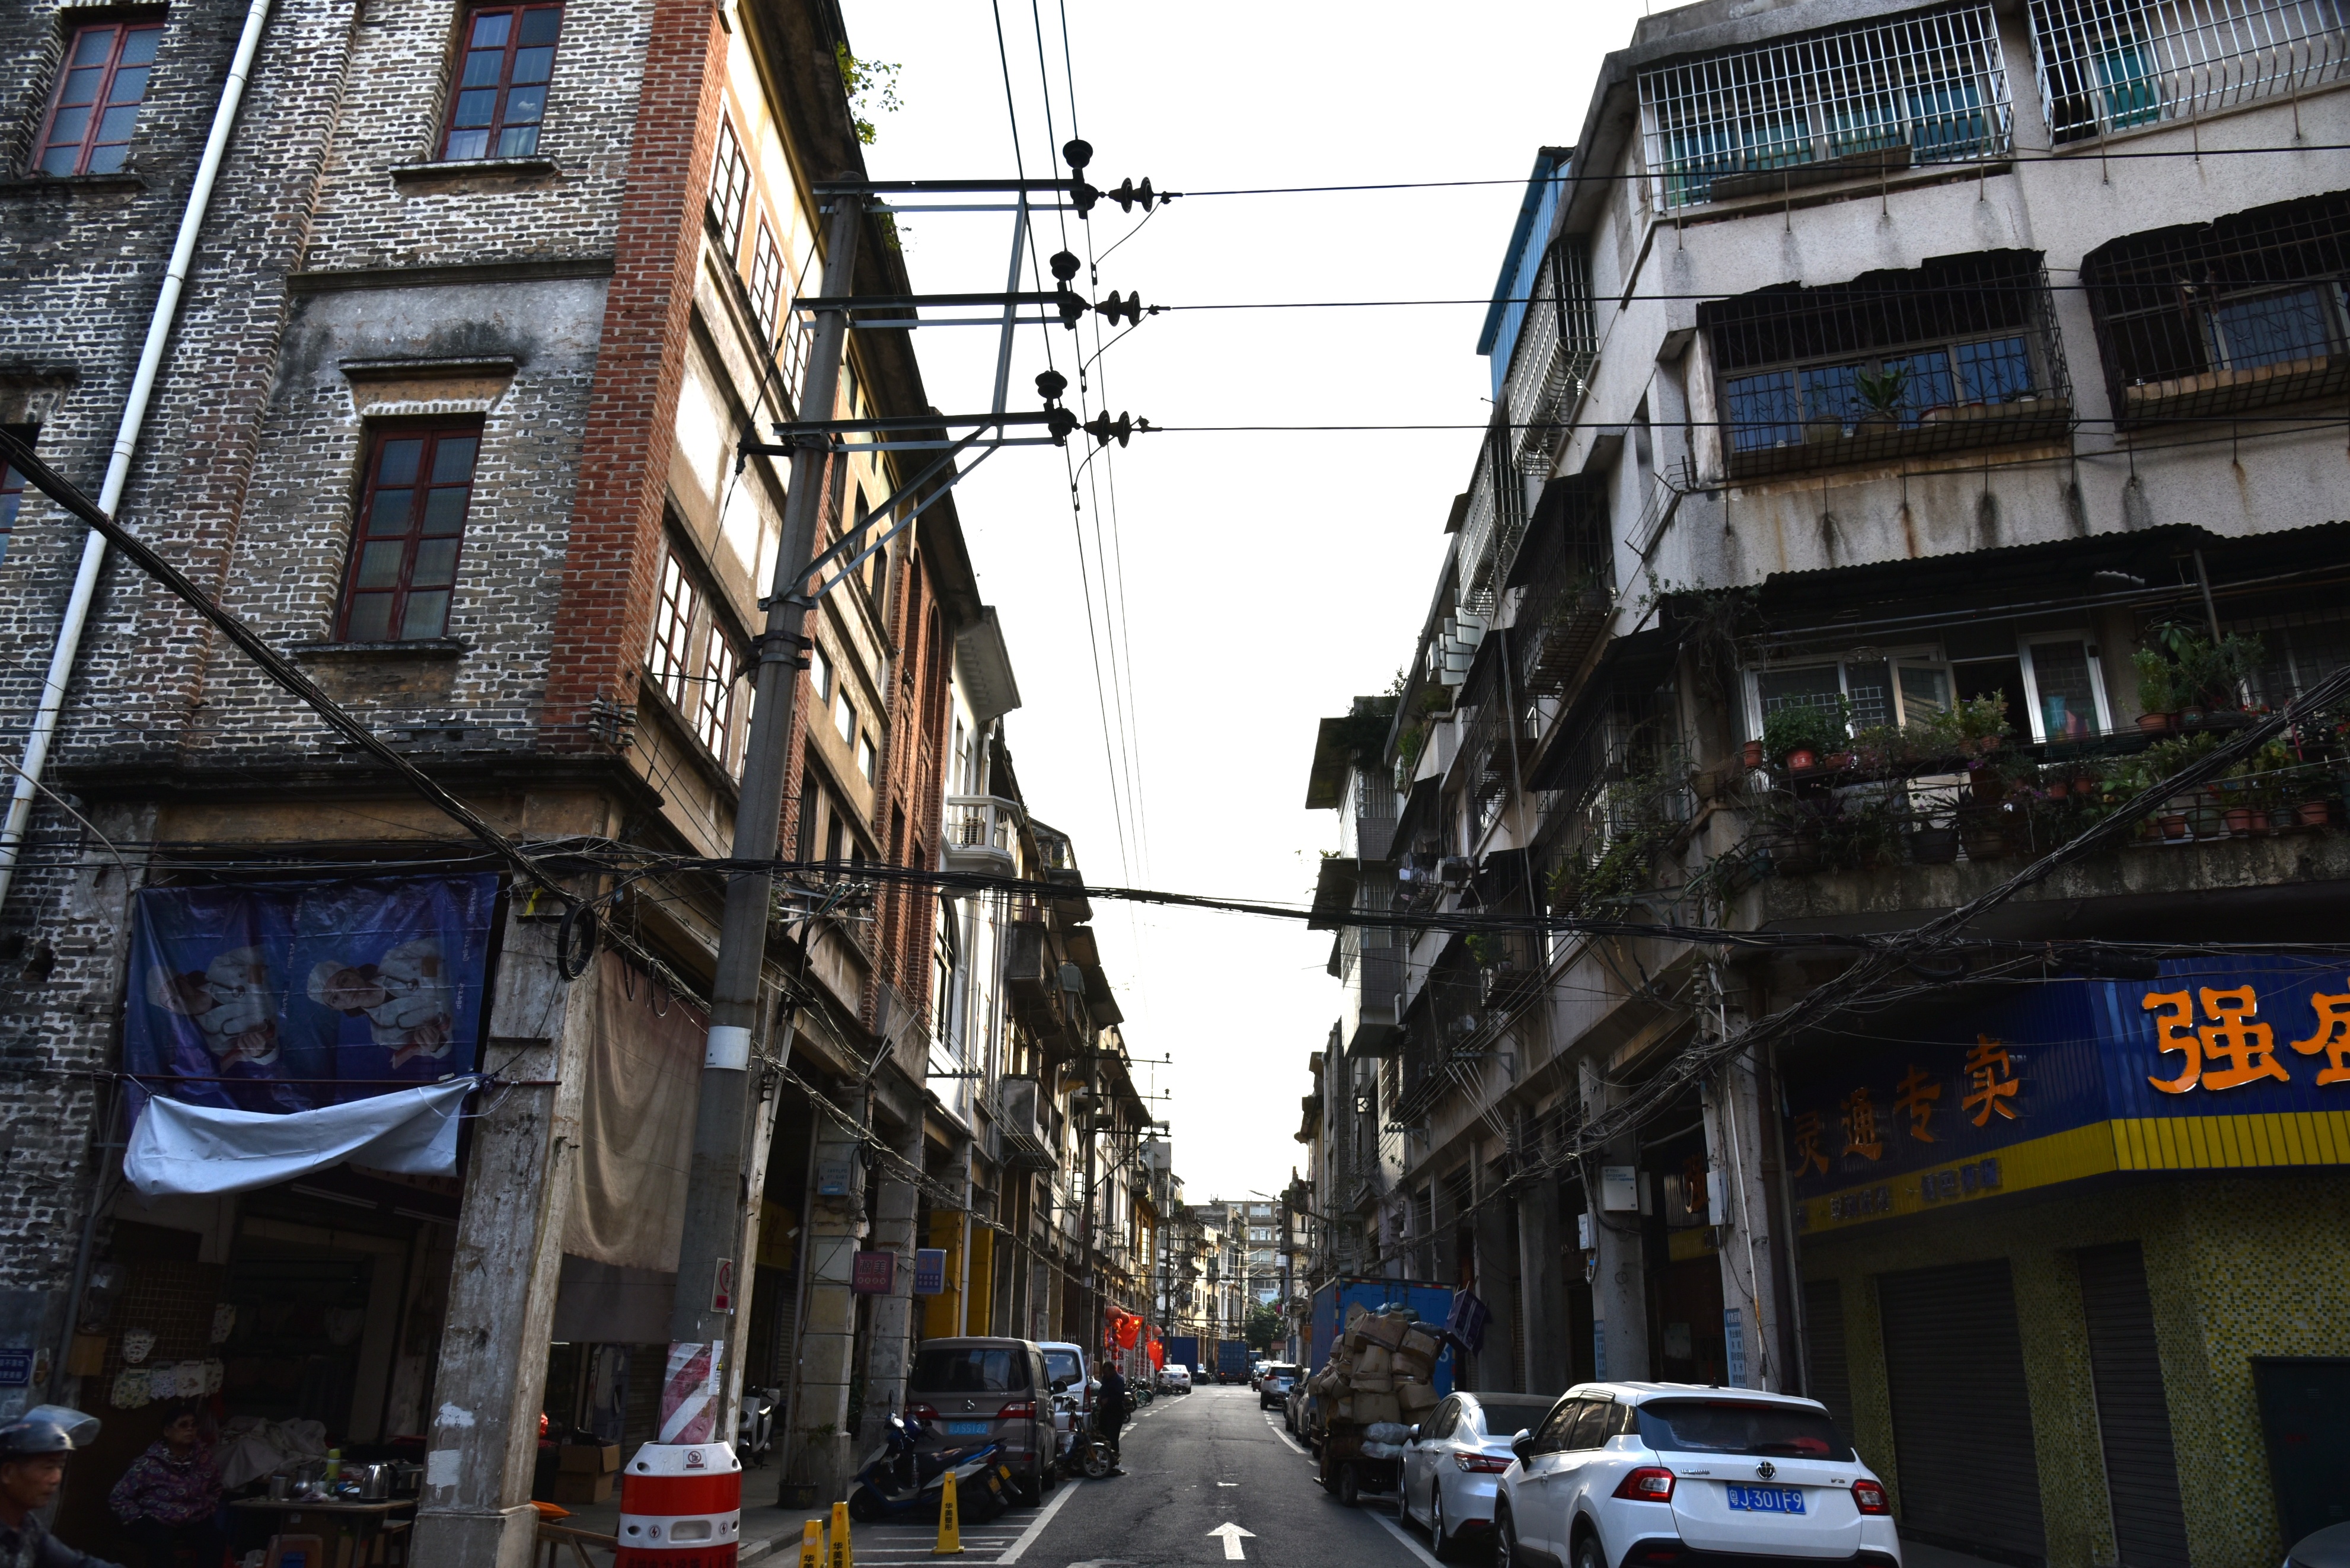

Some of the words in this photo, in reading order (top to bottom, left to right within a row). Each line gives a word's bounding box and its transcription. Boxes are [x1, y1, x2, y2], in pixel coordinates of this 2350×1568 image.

[1794, 1033, 2020, 1177] 灵通专卖
[858, 1259, 887, 1275] 源美
[945, 1502, 953, 1531] 华美整形
